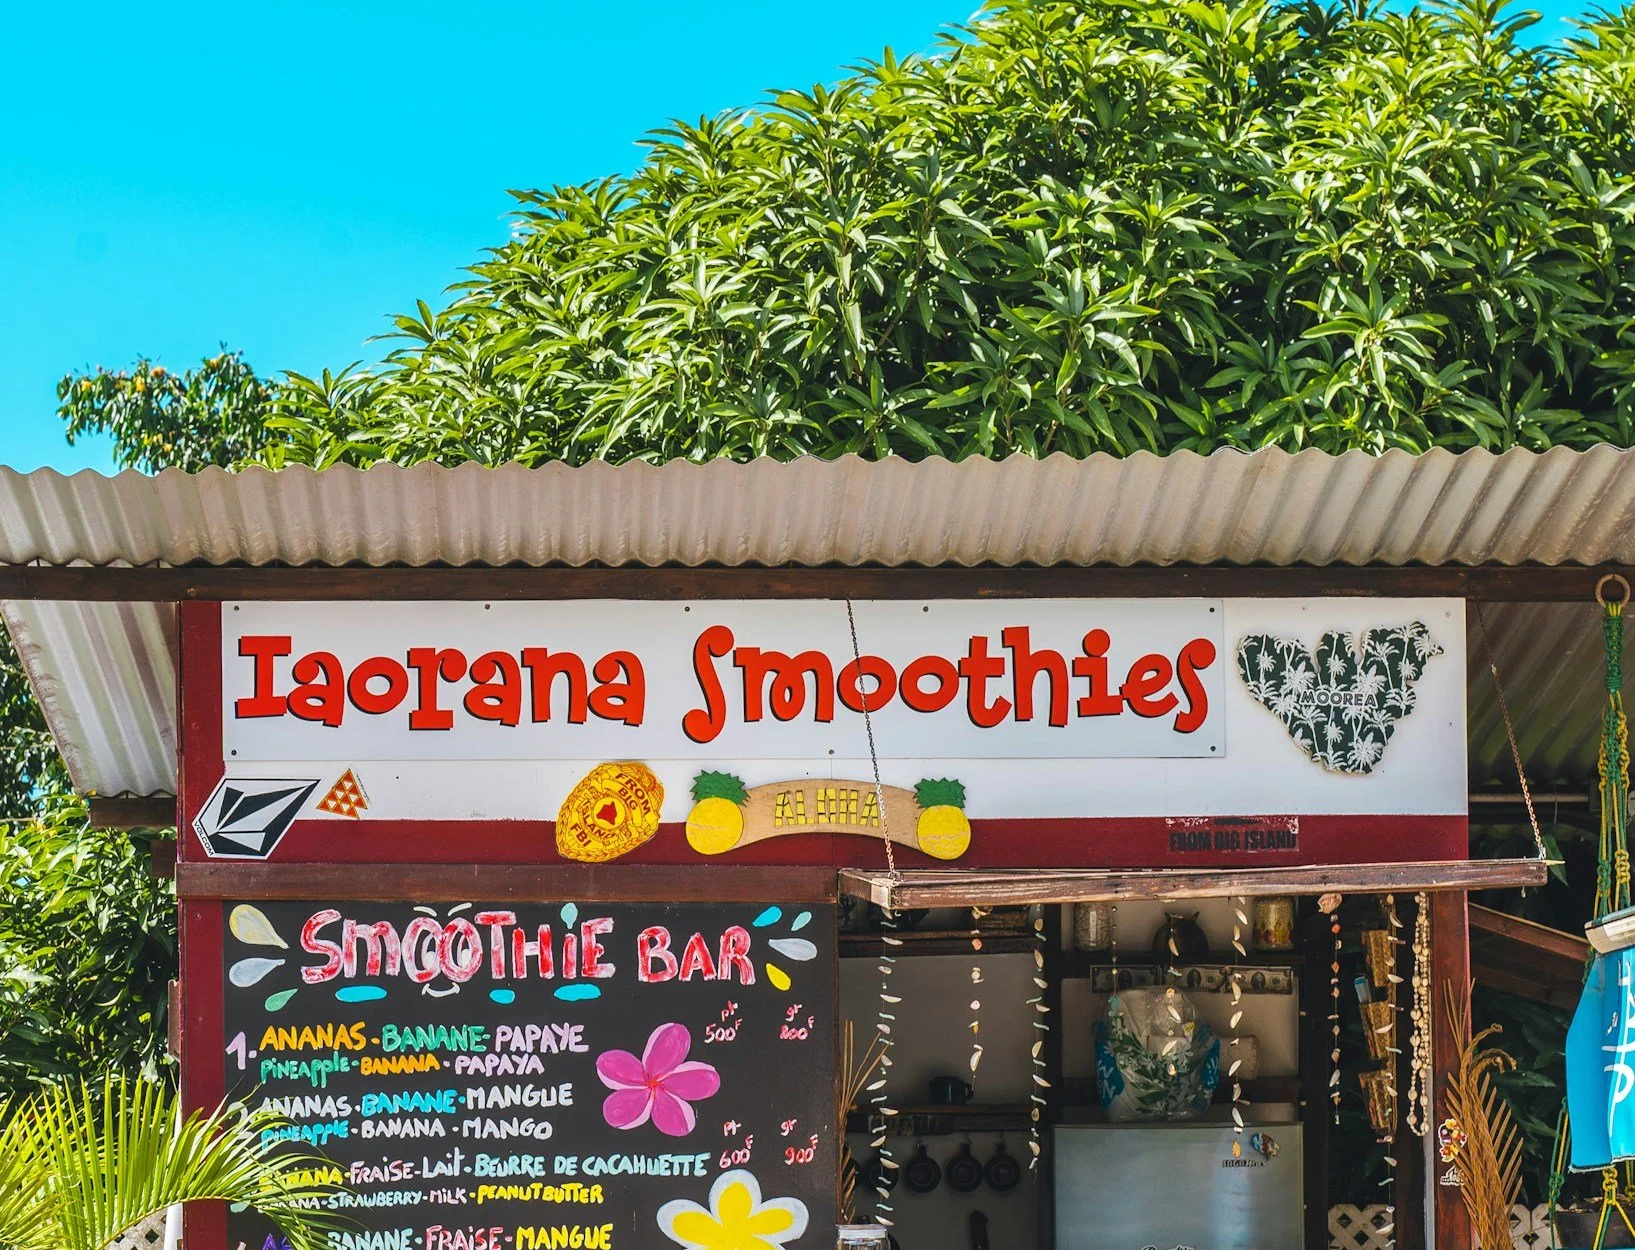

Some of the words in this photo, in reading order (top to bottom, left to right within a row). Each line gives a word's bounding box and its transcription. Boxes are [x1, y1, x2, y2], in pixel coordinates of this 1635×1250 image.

[235, 634, 646, 731] Iaorana
[682, 625, 1217, 744] Smoothies
[1300, 692, 1378, 707] MOOREA
[615, 773, 651, 815] FROM
[618, 787, 639, 811] BIG
[774, 787, 880, 827] ALOHA
[581, 799, 616, 839] ISLAND
[194, 821, 215, 856] VOLCOM
[570, 823, 592, 847] FBI
[1169, 830, 1211, 852] FROM
[1214, 830, 1240, 850] BIG
[1244, 829, 1297, 849] ISLAND
[637, 925, 756, 986] BAR
[259, 1021, 366, 1051] ANANAS
[382, 1024, 487, 1053] BANANE
[495, 1022, 589, 1053] PAPAYE
[360, 1053, 440, 1076] BANANA
[454, 1053, 545, 1077] PAPAYA
[361, 1089, 458, 1117] BANANE
[466, 1082, 574, 1109] MANGUE
[361, 1117, 446, 1139] BANANA
[462, 1116, 553, 1140] MANGO
[554, 1155, 578, 1176] DE
[582, 1152, 711, 1177] CACAHUETTE
[326, 1190, 423, 1209] STRAWBERRY
[516, 1223, 614, 1250] MANGUE
